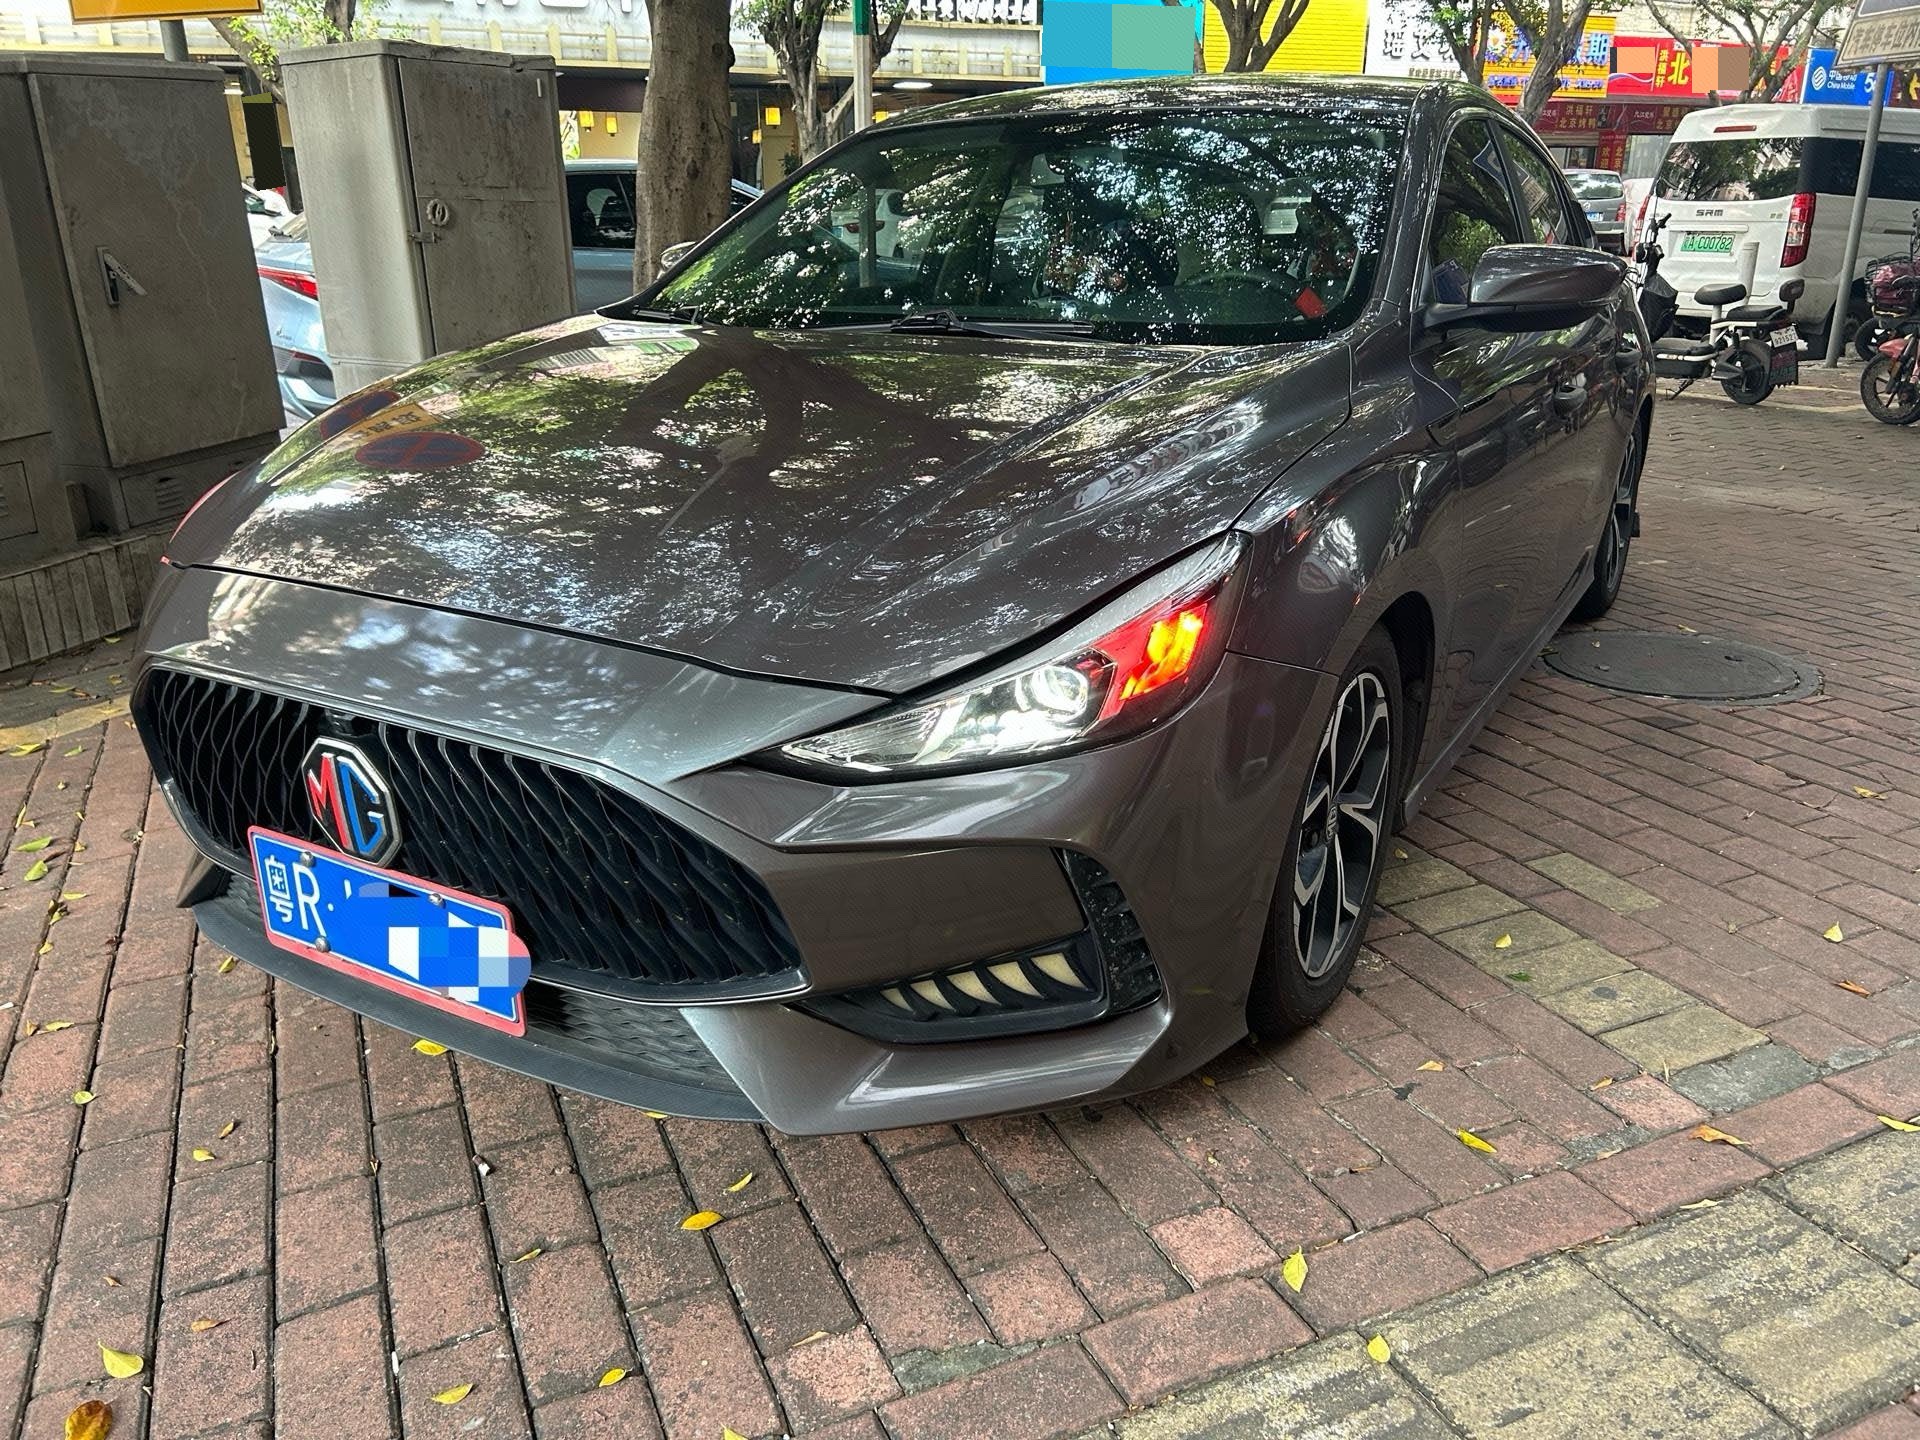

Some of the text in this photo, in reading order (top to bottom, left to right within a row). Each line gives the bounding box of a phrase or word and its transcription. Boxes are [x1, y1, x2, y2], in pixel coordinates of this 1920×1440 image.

[1827, 82, 1856, 90] China Mobile
[1696, 209, 1724, 217] SRM
[306, 752, 384, 856] MG
